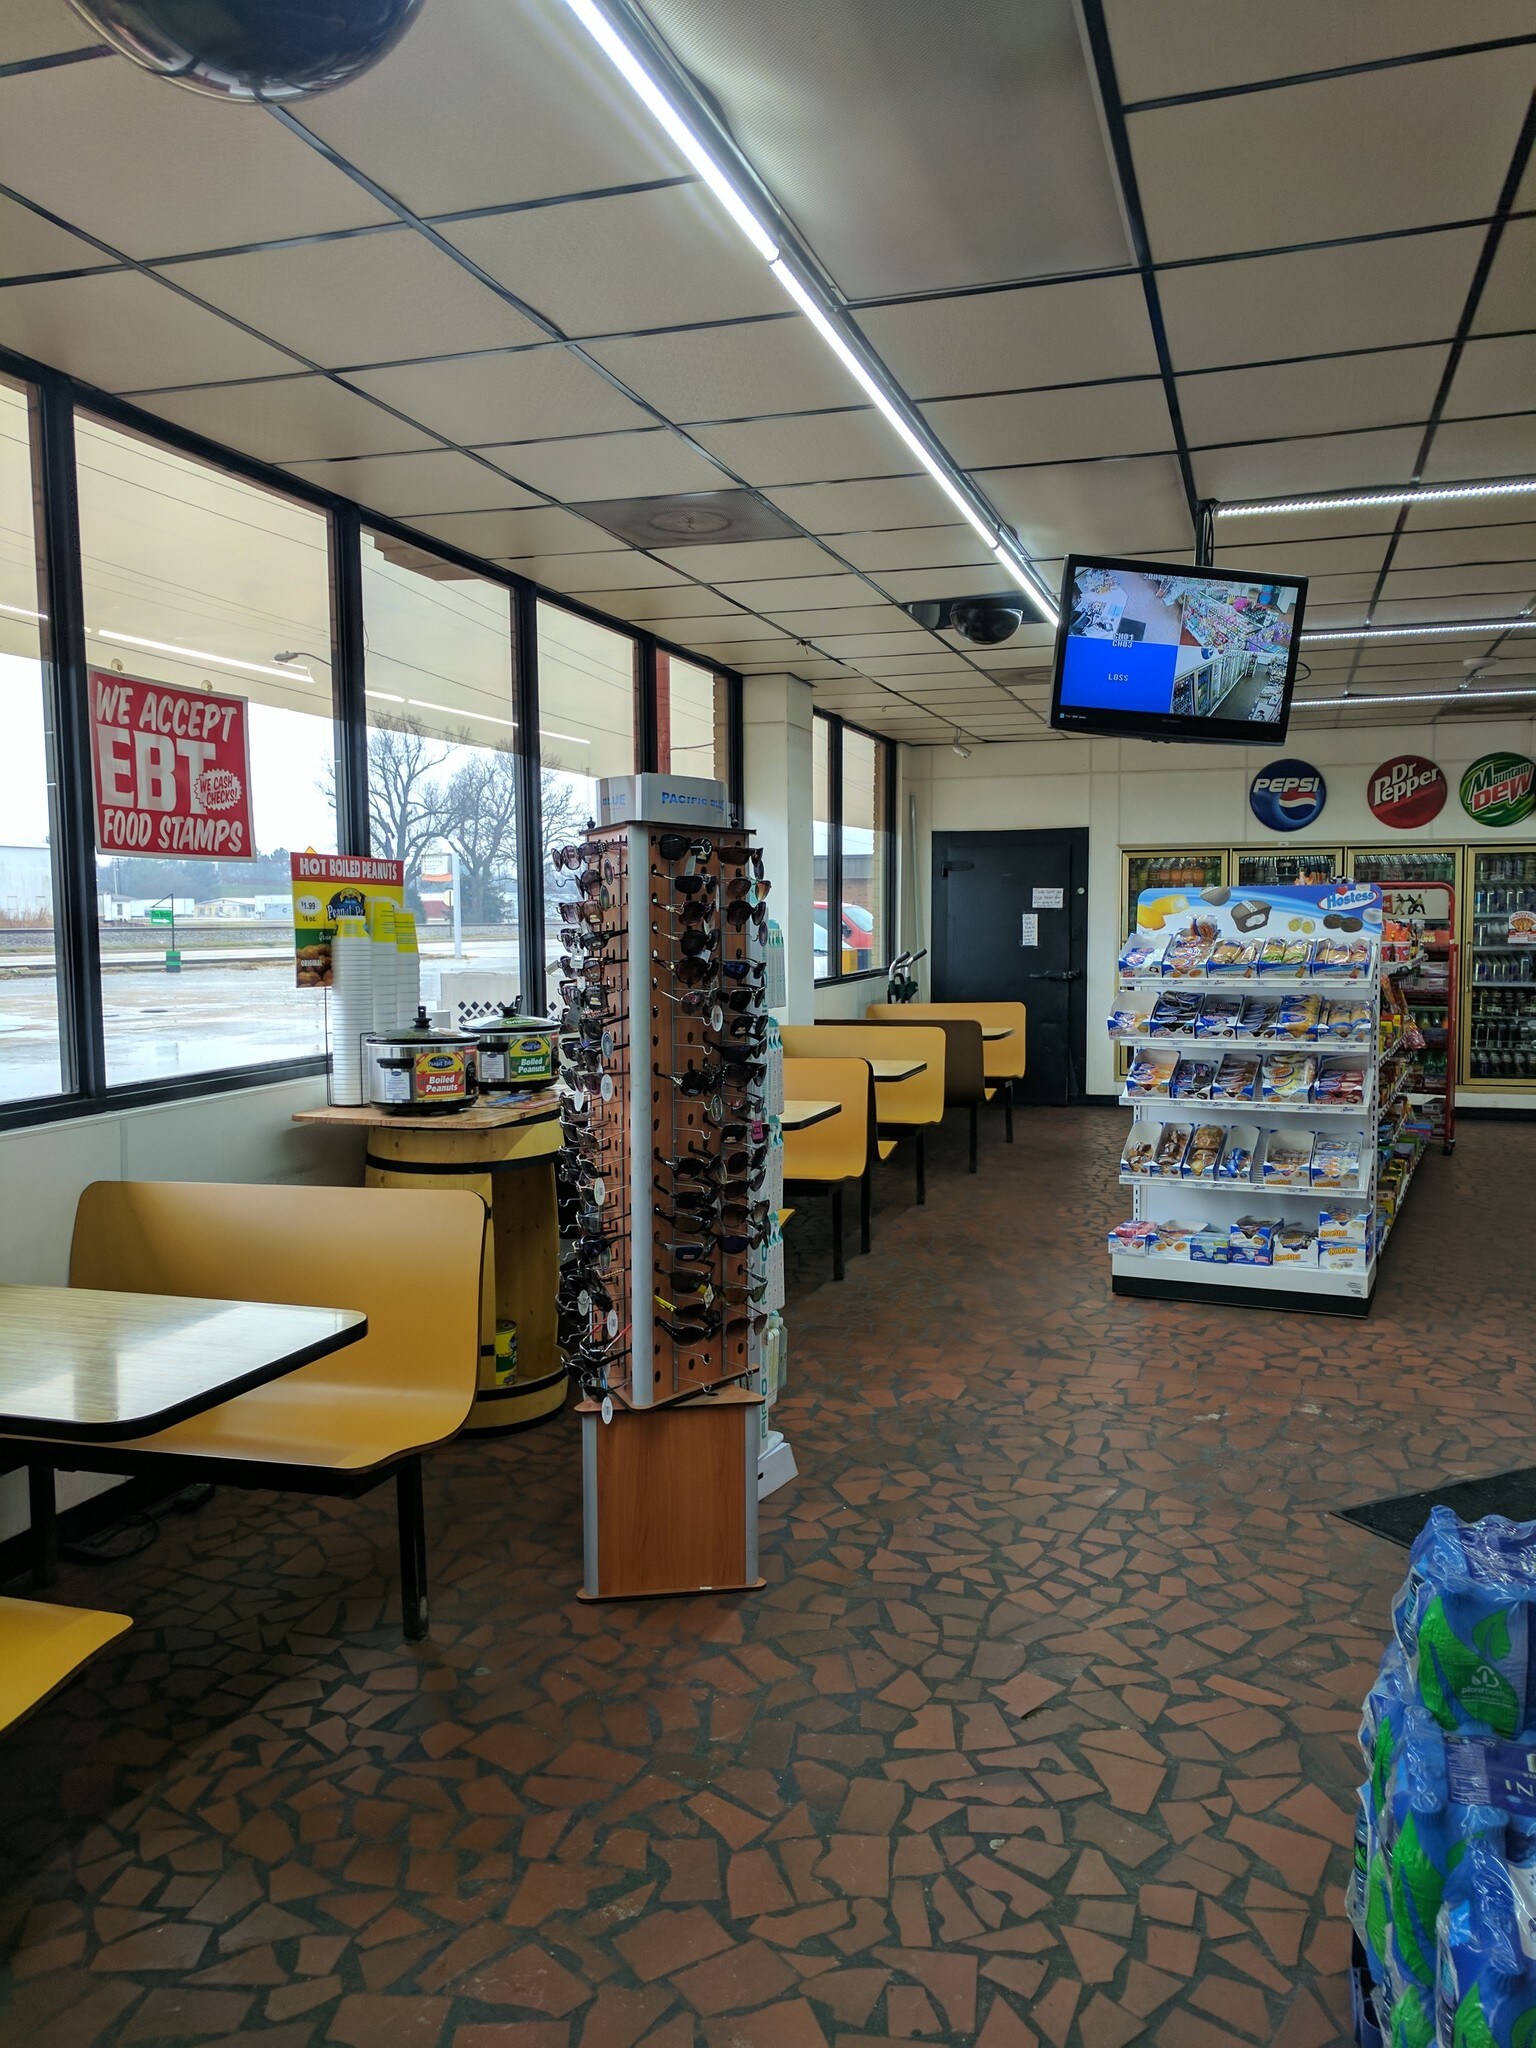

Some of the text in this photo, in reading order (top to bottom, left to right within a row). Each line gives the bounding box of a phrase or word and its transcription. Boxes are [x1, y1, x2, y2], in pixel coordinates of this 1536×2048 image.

[1112, 640, 1133, 648] CH03
[1108, 673, 1129, 682] LOSS
[97, 681, 237, 743] WE ACCEPT
[96, 723, 216, 815] EBT
[1392, 762, 1417, 785] Dr
[201, 775, 233, 793] WE CASH
[1253, 777, 1320, 793] PEPSI
[1373, 768, 1440, 806] Pepper
[1469, 763, 1530, 803] Mountain
[206, 789, 238, 805] CHECKS!
[661, 791, 708, 806] PACIFIC
[103, 809, 243, 853] FOOD STAMPS
[300, 857, 398, 881] HOT BOILED PEANUTS
[301, 901, 316, 910] $1.99
[1326, 890, 1375, 910] Hostess
[518, 1065, 546, 1073] Peanuts
[521, 1057, 543, 1066] Boiled
[429, 1075, 455, 1084] Boiled
[426, 1084, 458, 1093] Peanuts
[1328, 1246, 1358, 1256] donettes
